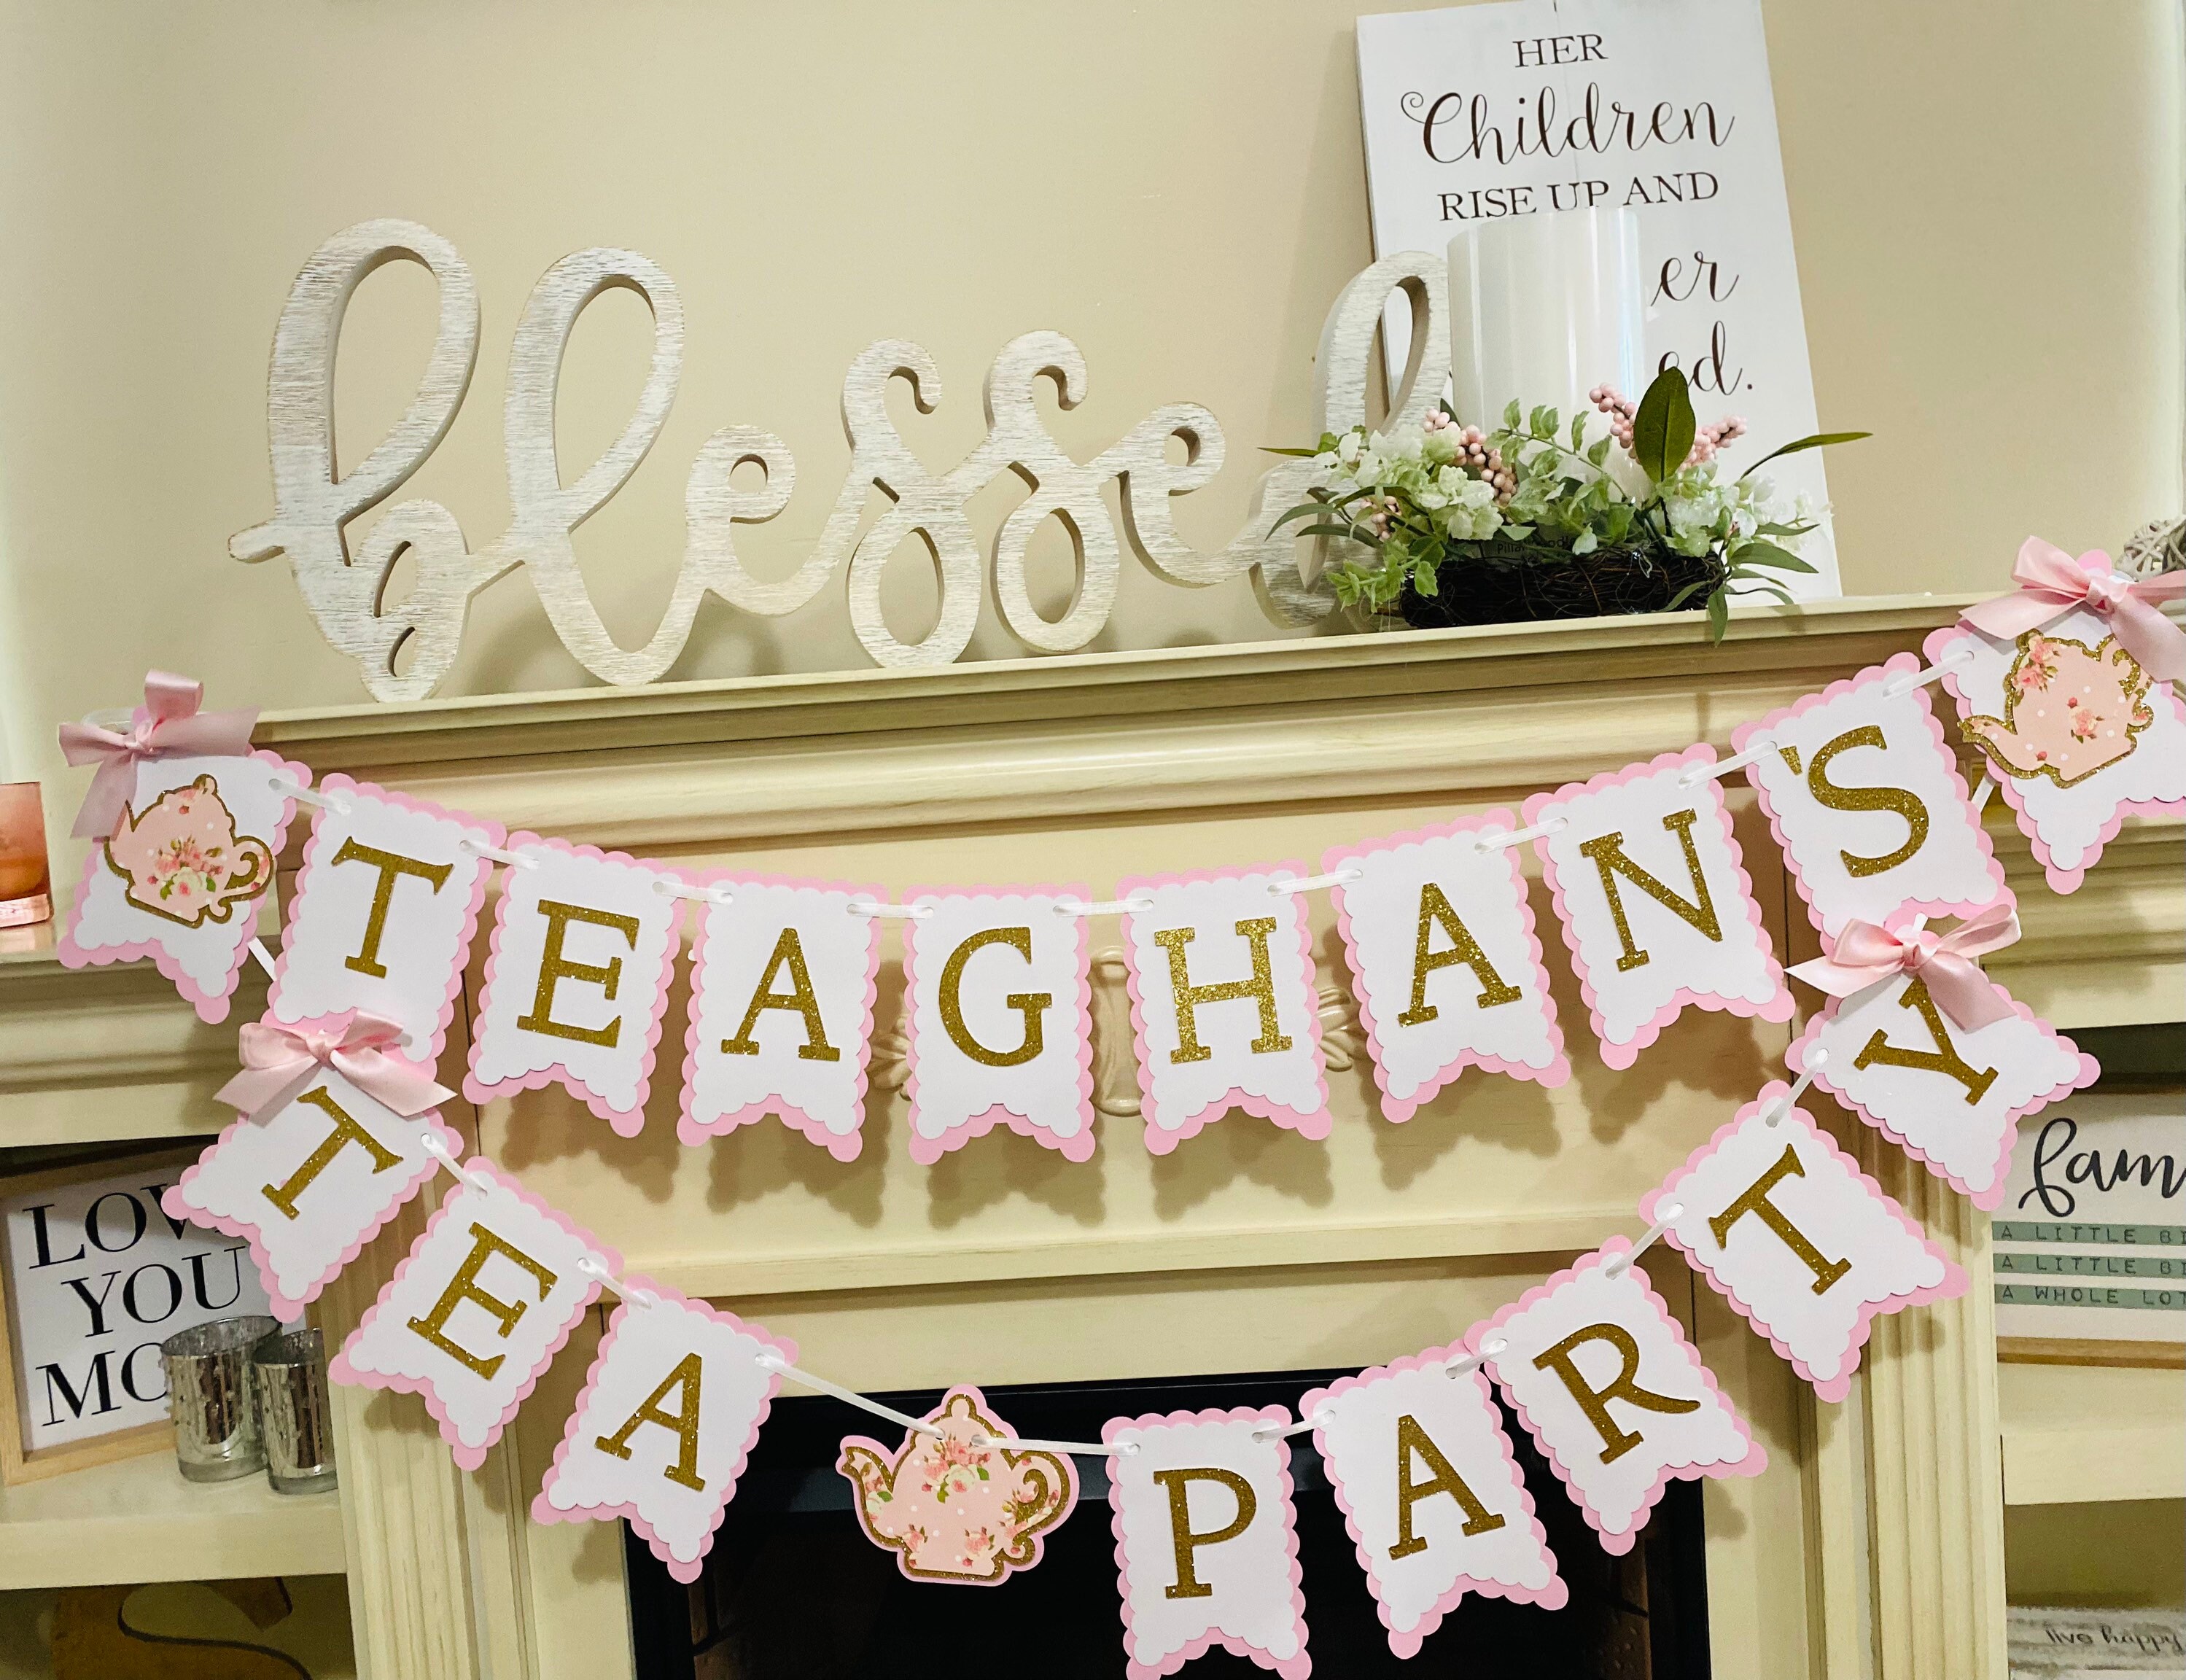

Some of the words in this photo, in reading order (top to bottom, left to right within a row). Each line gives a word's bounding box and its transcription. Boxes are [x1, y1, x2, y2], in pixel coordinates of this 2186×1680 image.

[1512, 34, 1609, 68] HER
[1401, 82, 1735, 166] Children
[1437, 186, 1538, 222] RISE
[1546, 179, 1610, 211] UP
[1622, 171, 1719, 207] AND
[2018, 1117, 2186, 1218] fam
[23, 1183, 191, 1269] LOV
[2001, 1225, 2012, 1240] A
[2035, 1225, 2136, 1244] LITTLE
[2160, 1229, 2186, 1245] BI
[2002, 1255, 2013, 1270] A
[2036, 1256, 2137, 1275] LITTLE
[2160, 1260, 2186, 1275] BI
[61, 1245, 246, 1338] YOU
[261, 1084, 706, 1493] TEA
[1153, 976, 1999, 1601] PARTY
[2002, 1285, 2014, 1300] A
[2034, 1286, 2119, 1304] WHOLE
[35, 1342, 168, 1427] MO
